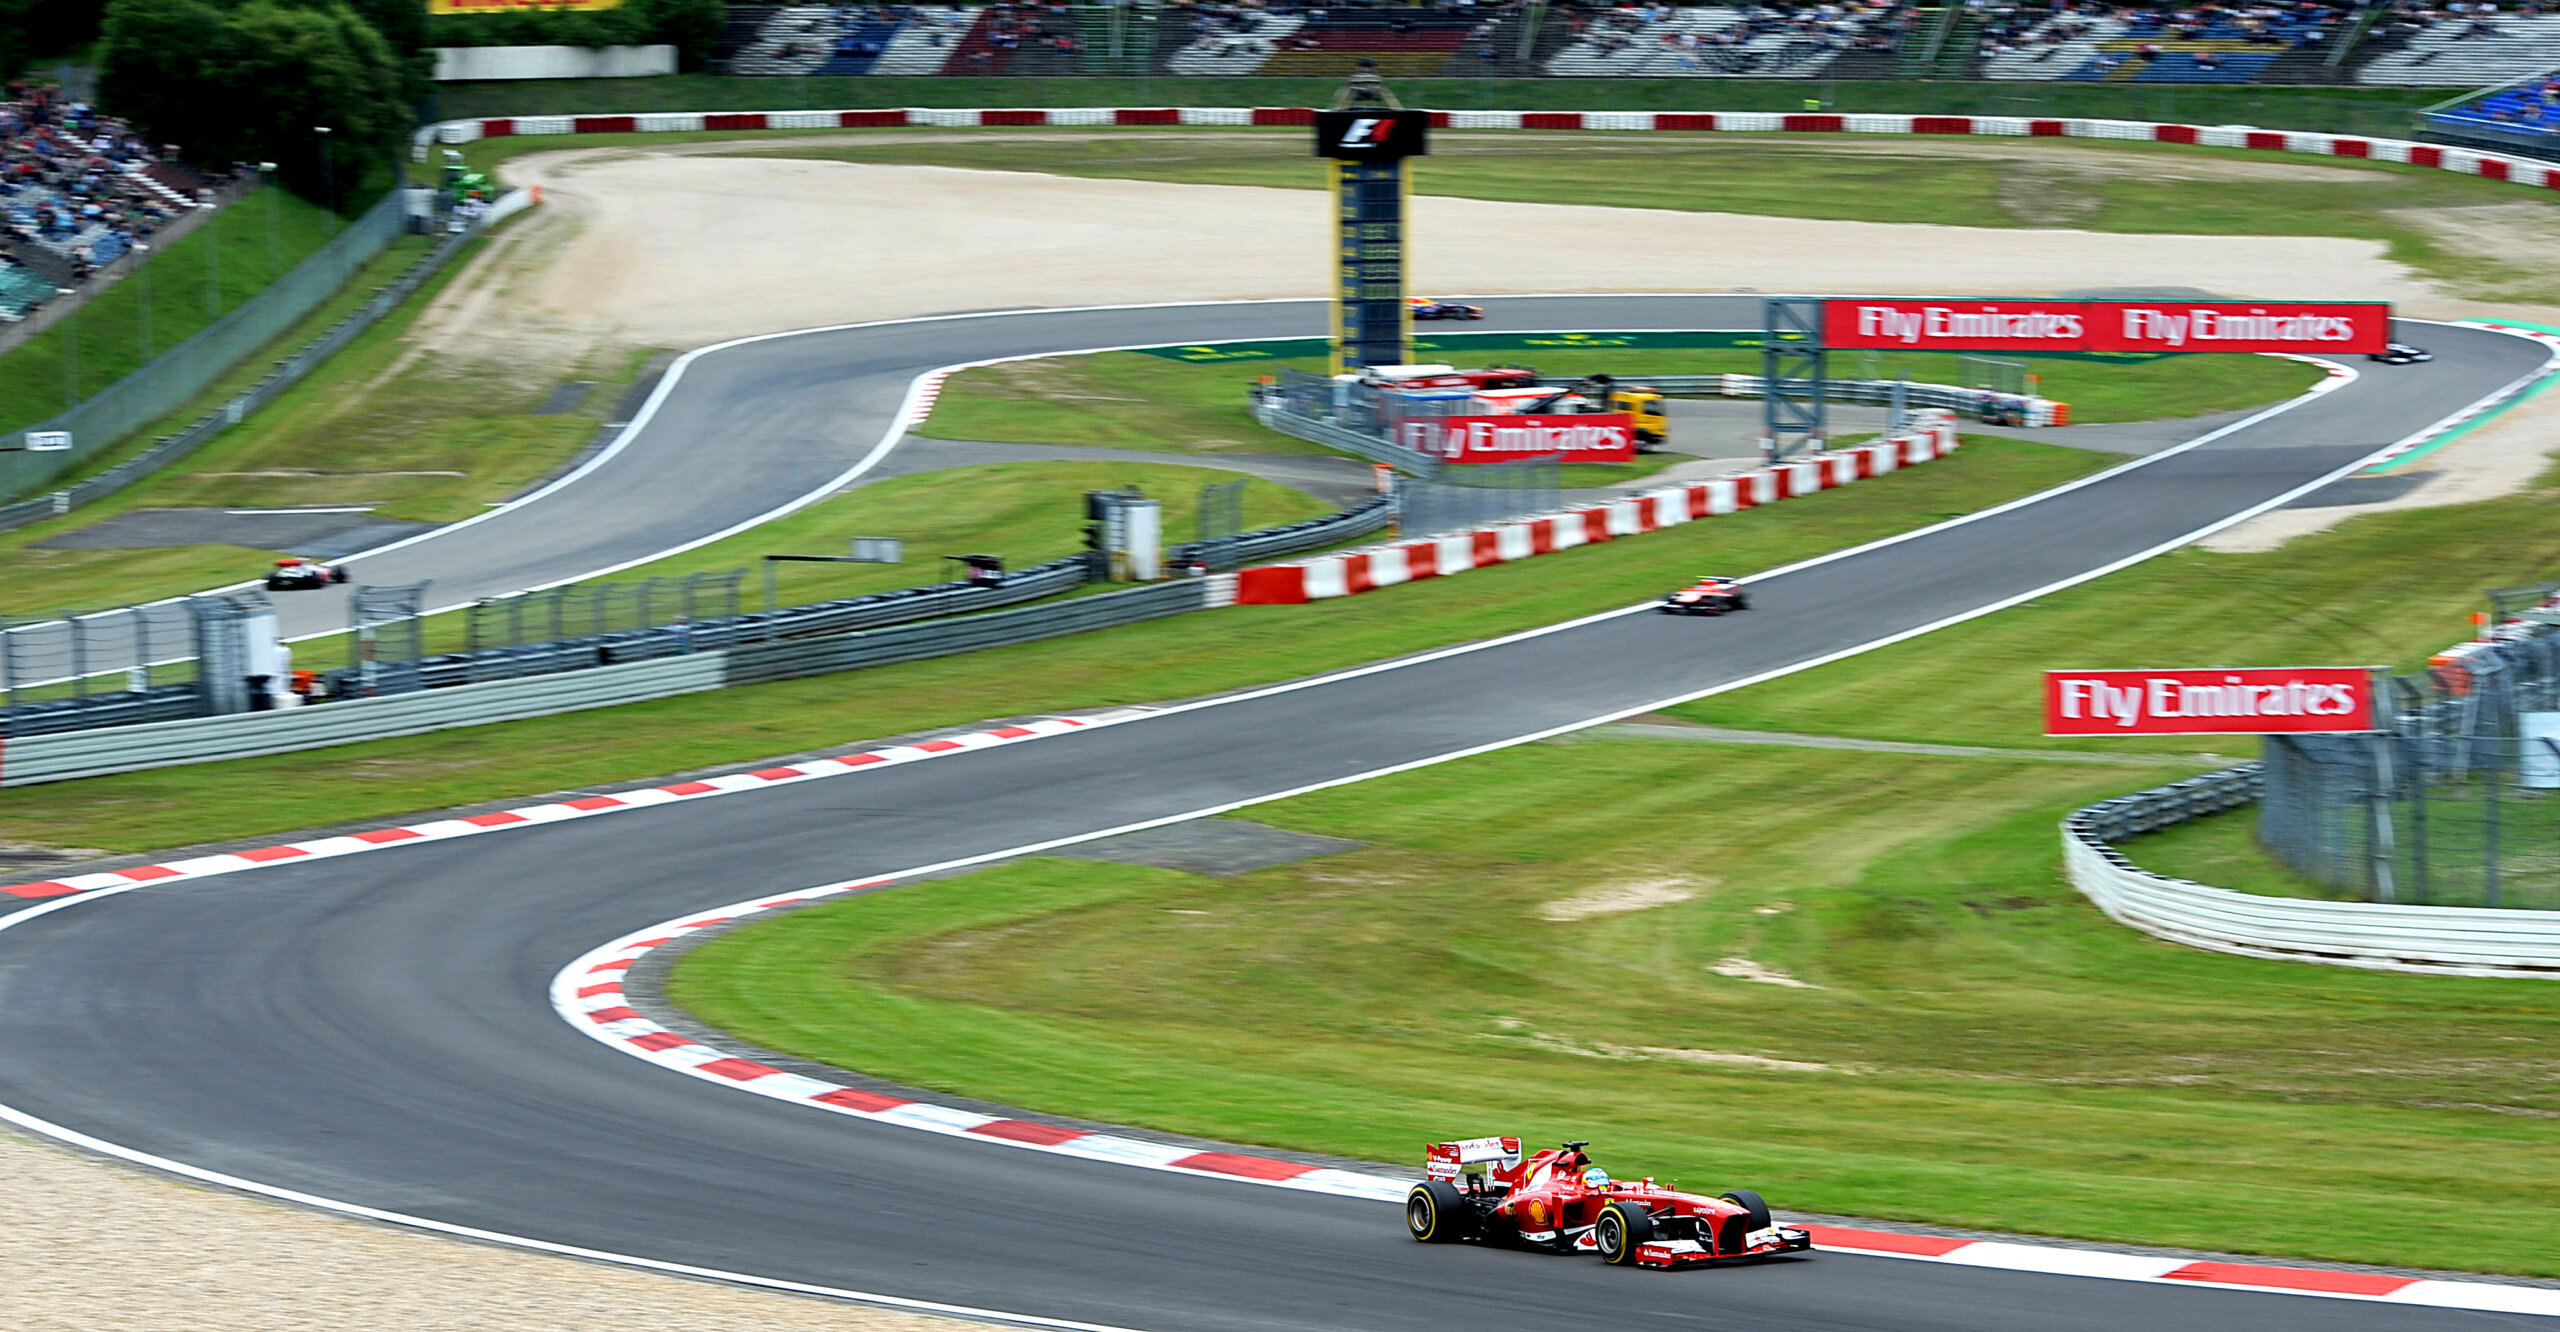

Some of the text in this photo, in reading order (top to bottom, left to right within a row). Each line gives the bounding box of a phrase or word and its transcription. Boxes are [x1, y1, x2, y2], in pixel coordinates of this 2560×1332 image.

[1341, 118, 1398, 142] F1
[1857, 306, 2085, 343] Fly Emirates
[2122, 308, 2354, 346] Fly Emirates
[1402, 420, 1627, 458] Fly Emirates
[2058, 676, 2356, 727] Fly Emirates
